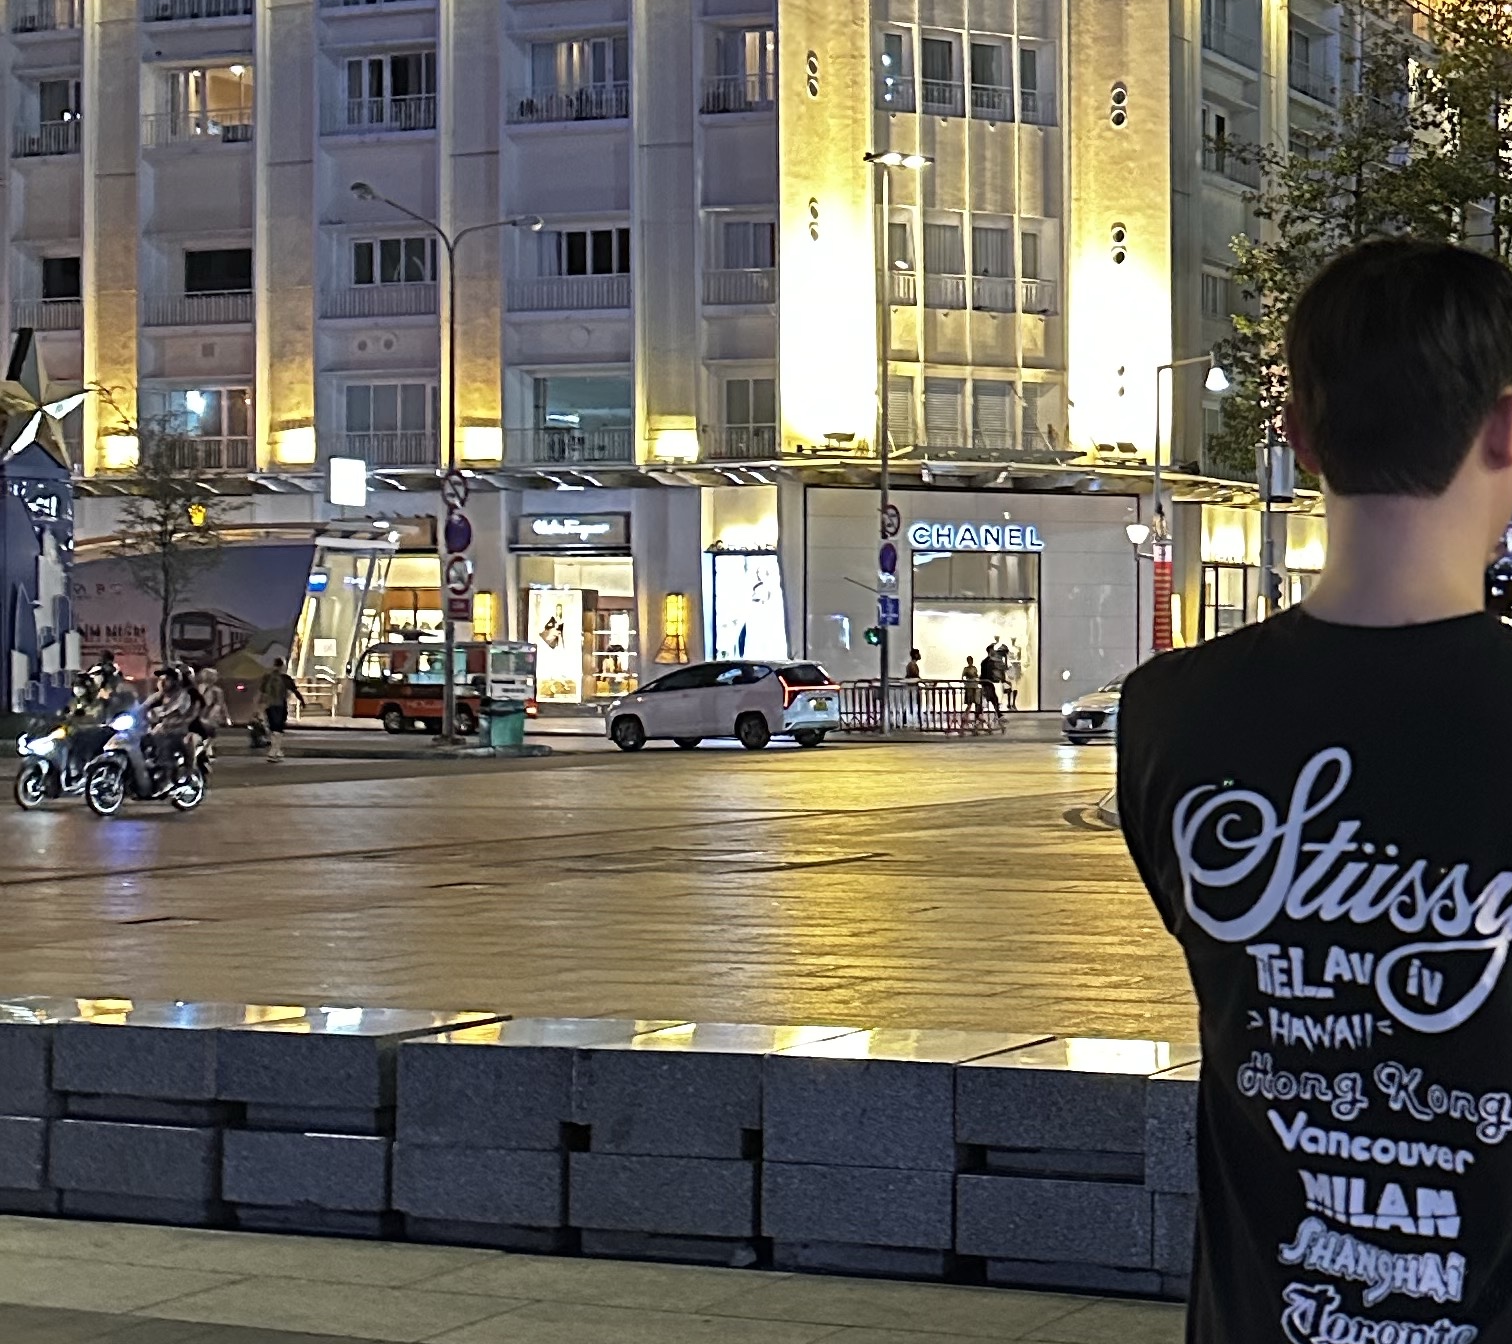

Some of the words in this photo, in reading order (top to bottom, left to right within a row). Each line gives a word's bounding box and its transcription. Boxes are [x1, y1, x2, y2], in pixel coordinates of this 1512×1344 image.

[910, 524, 1044, 549] CHANEL
[1245, 943, 1334, 999] TEL
[1267, 1007, 1375, 1053] HAWAII
[1237, 1052, 1368, 1121] Hong
[1267, 1109, 1476, 1174] Vancouver
[1297, 1169, 1462, 1239] MILAN
